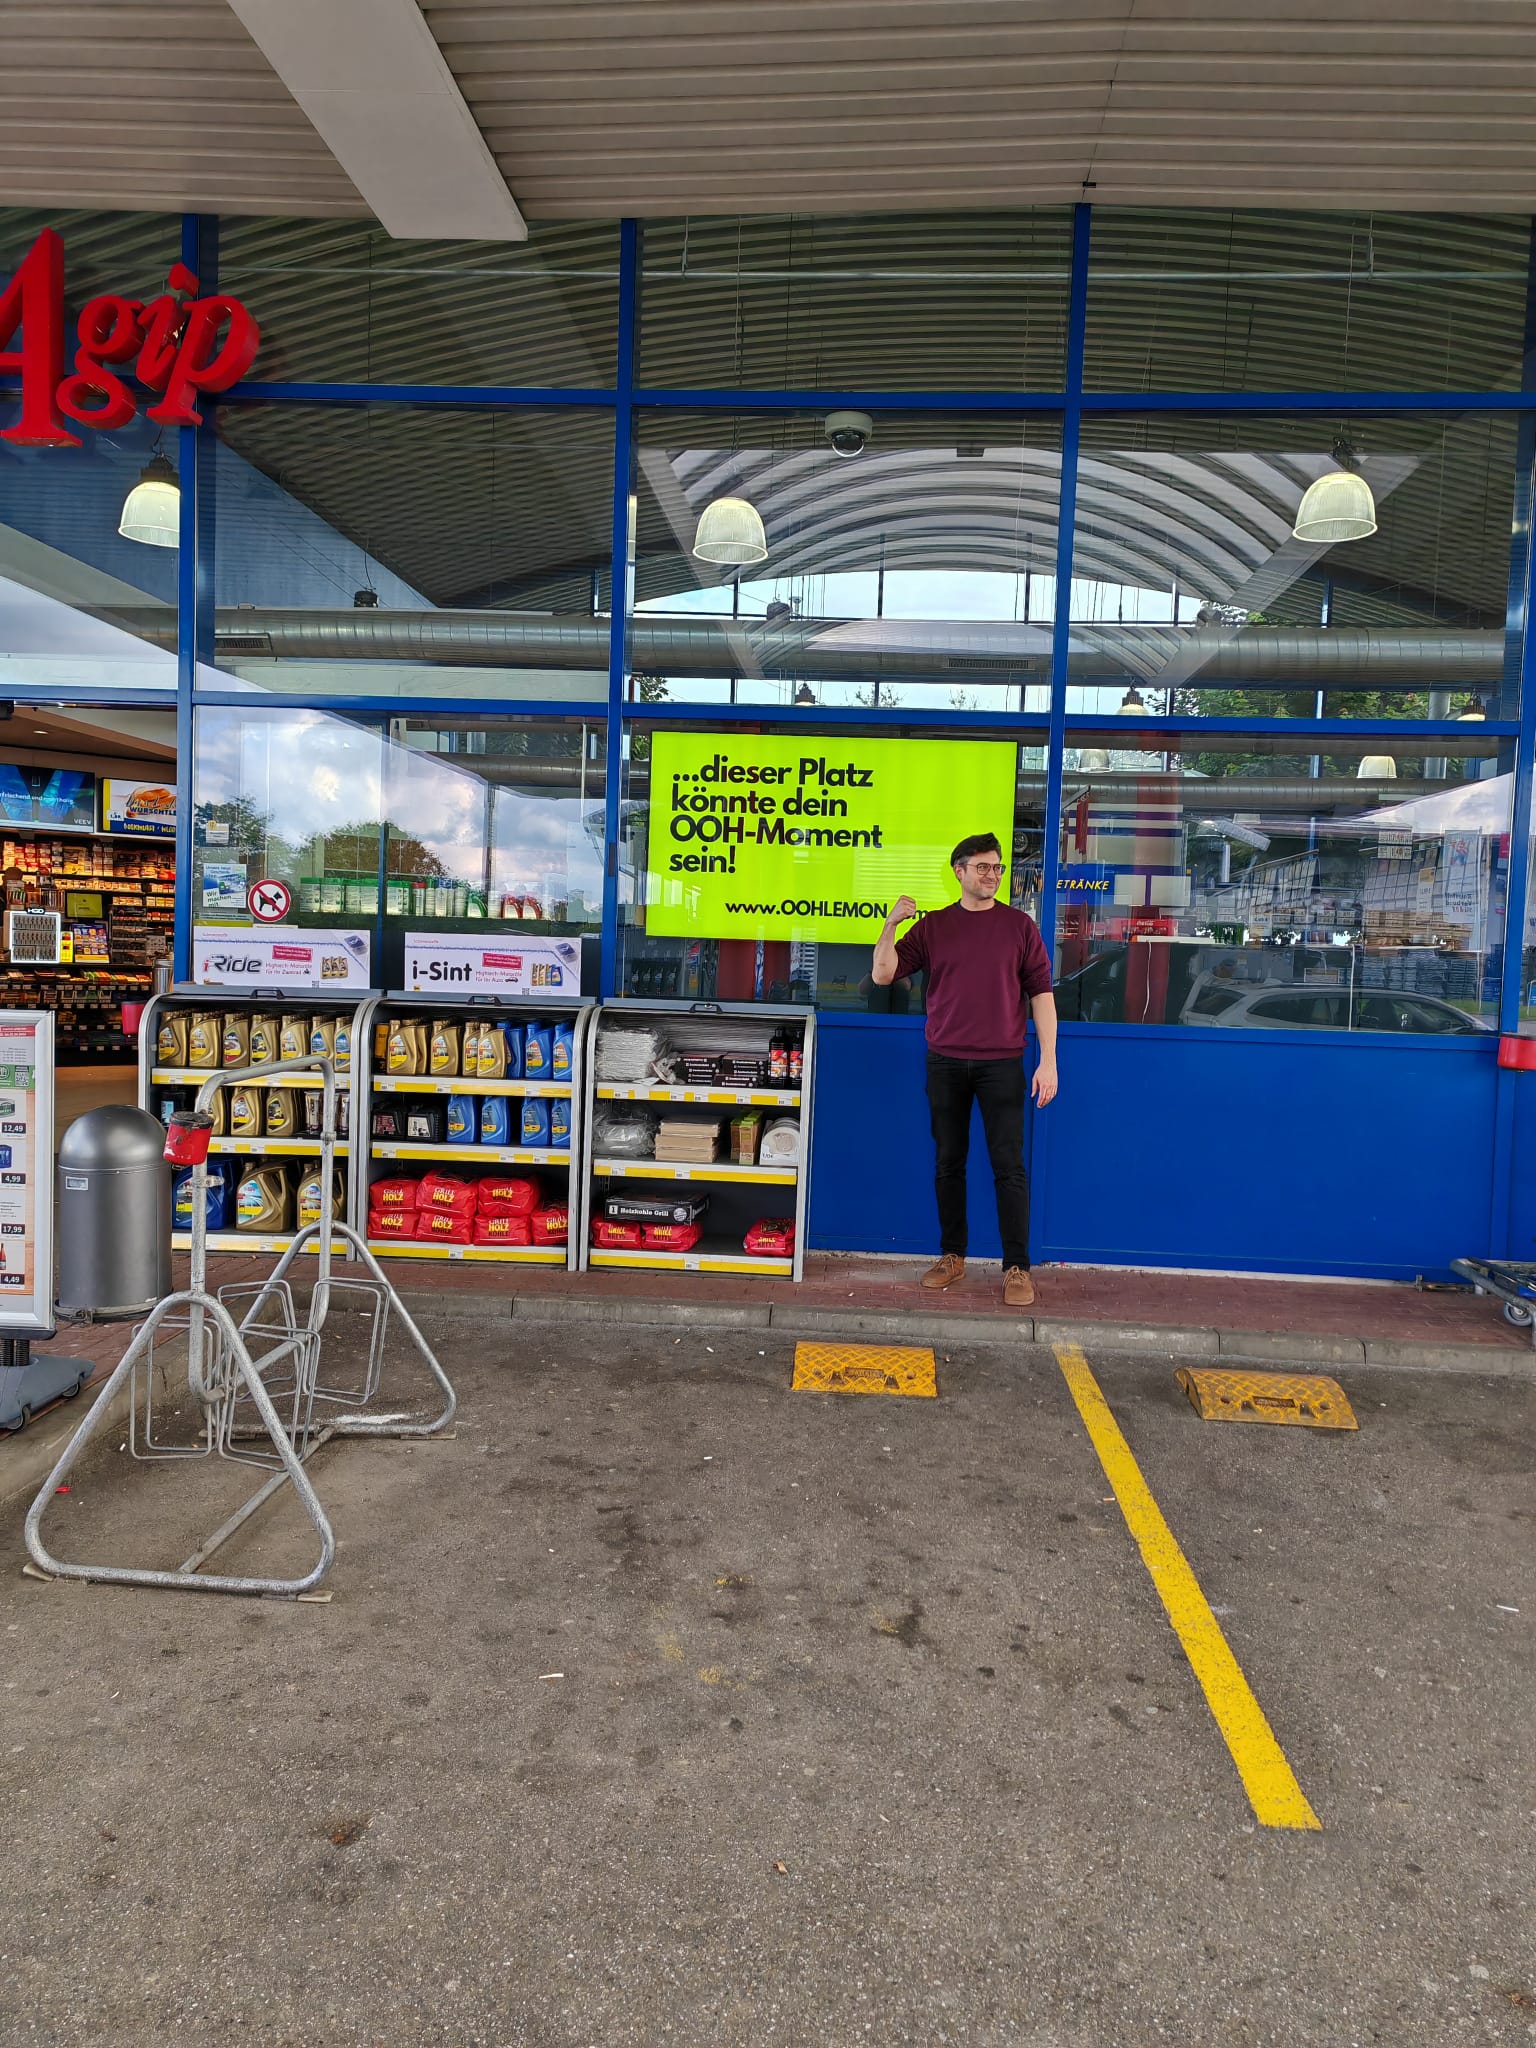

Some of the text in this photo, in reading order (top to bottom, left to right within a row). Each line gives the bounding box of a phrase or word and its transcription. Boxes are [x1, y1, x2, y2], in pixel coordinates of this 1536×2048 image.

[0, 226, 261, 448] Agip
[672, 754, 874, 788] ...dieser Platz
[672, 783, 848, 817] könnte dein
[669, 815, 883, 849] OOH-Moment
[669, 845, 737, 874] sein!
[1056, 878, 1110, 891] ETRÄNKE
[724, 899, 929, 921] www.OOHLEMONm
[412, 960, 473, 982] i-Sint
[3, 1124, 24, 1133] 12,49
[4, 1175, 21, 1183] 4,99
[383, 1193, 404, 1201] HOLZ
[432, 1193, 455, 1203] HOLZ
[492, 1188, 513, 1198] HOLZ
[381, 1217, 403, 1226] HOLZ
[432, 1220, 453, 1229] HOLZ
[546, 1219, 568, 1231] HOLZ
[2, 1225, 23, 1233] 17,99
[488, 1224, 510, 1232] HOLZ
[3, 1275, 20, 1284] 4,49
